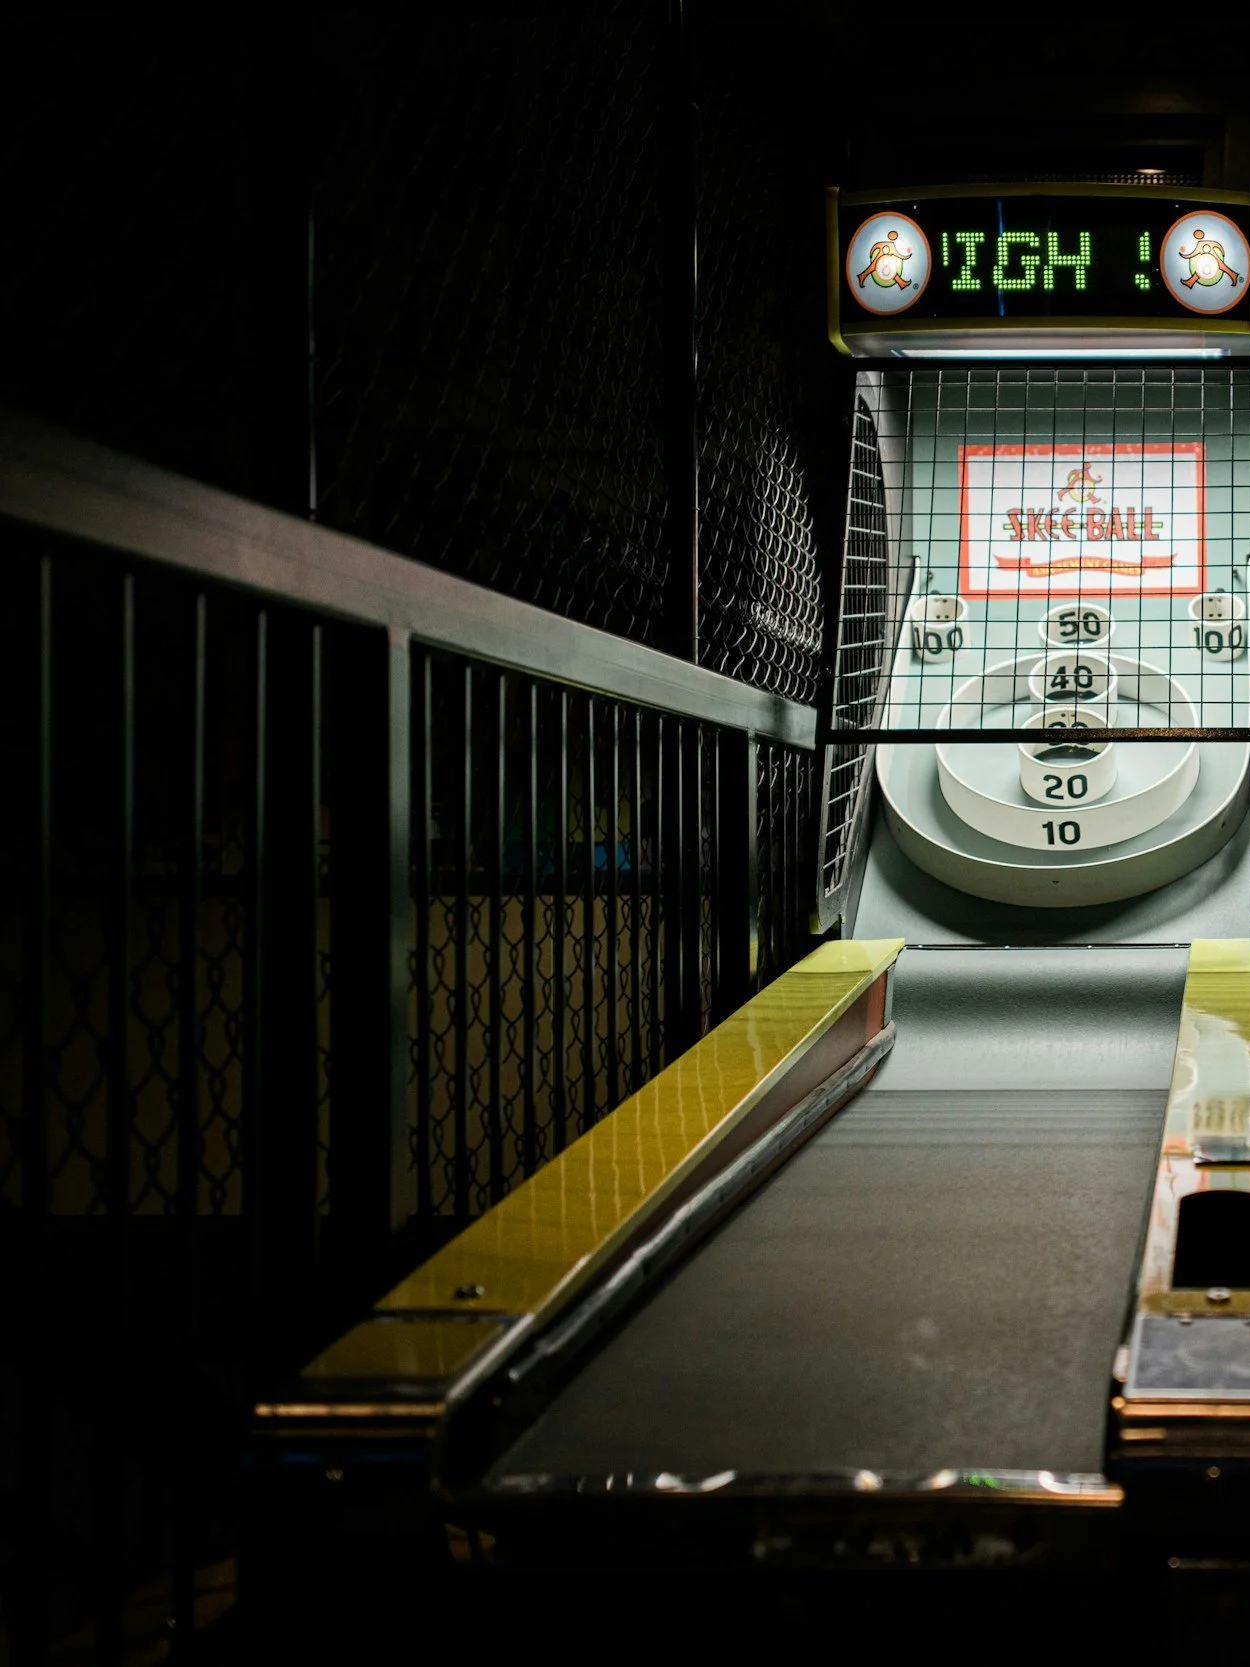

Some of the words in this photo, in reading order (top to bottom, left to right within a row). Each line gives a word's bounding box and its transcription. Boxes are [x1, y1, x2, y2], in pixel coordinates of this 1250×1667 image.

[1058, 611, 1101, 637] 50
[913, 624, 964, 655] 100
[1193, 624, 1243, 655] 100
[1050, 665, 1094, 690] 40
[1043, 774, 1089, 800] 20
[1041, 820, 1081, 846] 10
